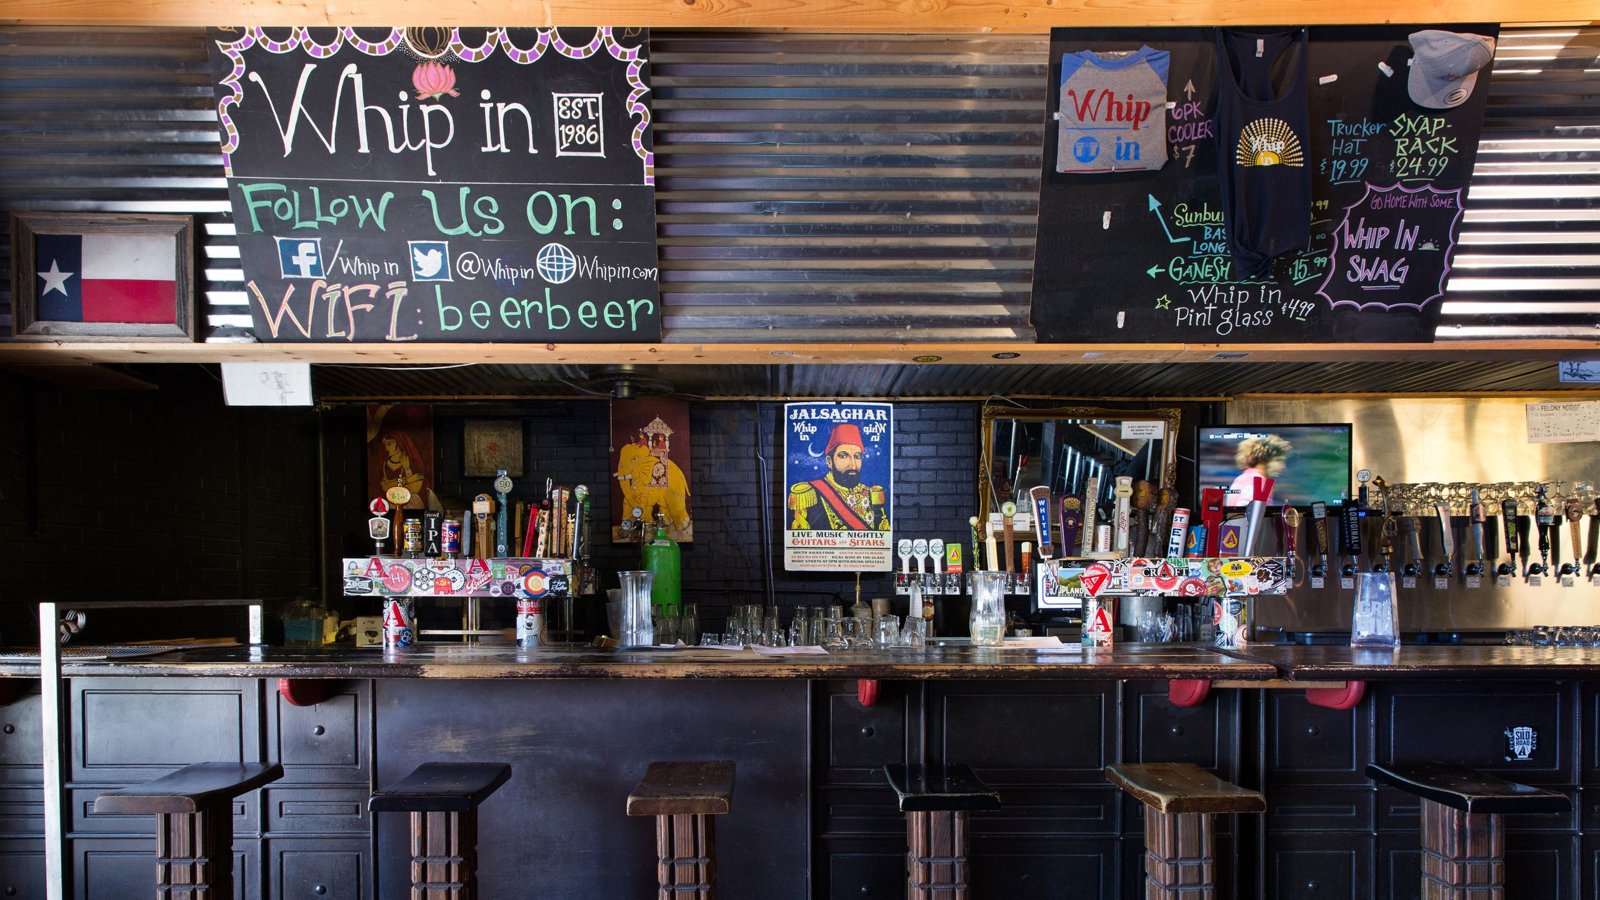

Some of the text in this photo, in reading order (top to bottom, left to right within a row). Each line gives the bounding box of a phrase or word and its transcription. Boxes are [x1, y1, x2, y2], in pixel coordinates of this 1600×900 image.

[249, 63, 538, 176] Whip in
[558, 96, 598, 120] EST.
[1068, 88, 1151, 131] Whip
[1171, 101, 1204, 120] 6PK
[560, 124, 598, 148] 1986
[1168, 119, 1214, 143] COOLER
[1389, 113, 1452, 137] SNAP-
[1115, 135, 1140, 161] in
[1250, 134, 1285, 154] Whip
[1394, 137, 1458, 157] BACK
[1320, 158, 1369, 183] $19.99
[1389, 156, 1449, 177] $24.99
[1384, 194, 1408, 209] HOME
[1343, 217, 1420, 251] WHIP IN
[576, 250, 658, 283] Whipin.com
[1346, 254, 1410, 284] SWAG
[1187, 284, 1282, 310] Whip in
[1281, 299, 1315, 318] $4.99
[1174, 303, 1274, 335] Pint glass
[789, 408, 888, 420] JALSAGHAR
[793, 421, 817, 434] Whip
[800, 432, 810, 441] in
[1037, 499, 1048, 536] WHITE
[428, 517, 439, 553] IPA
[791, 538, 837, 546] GUITARS
[849, 539, 885, 547] SITARS
